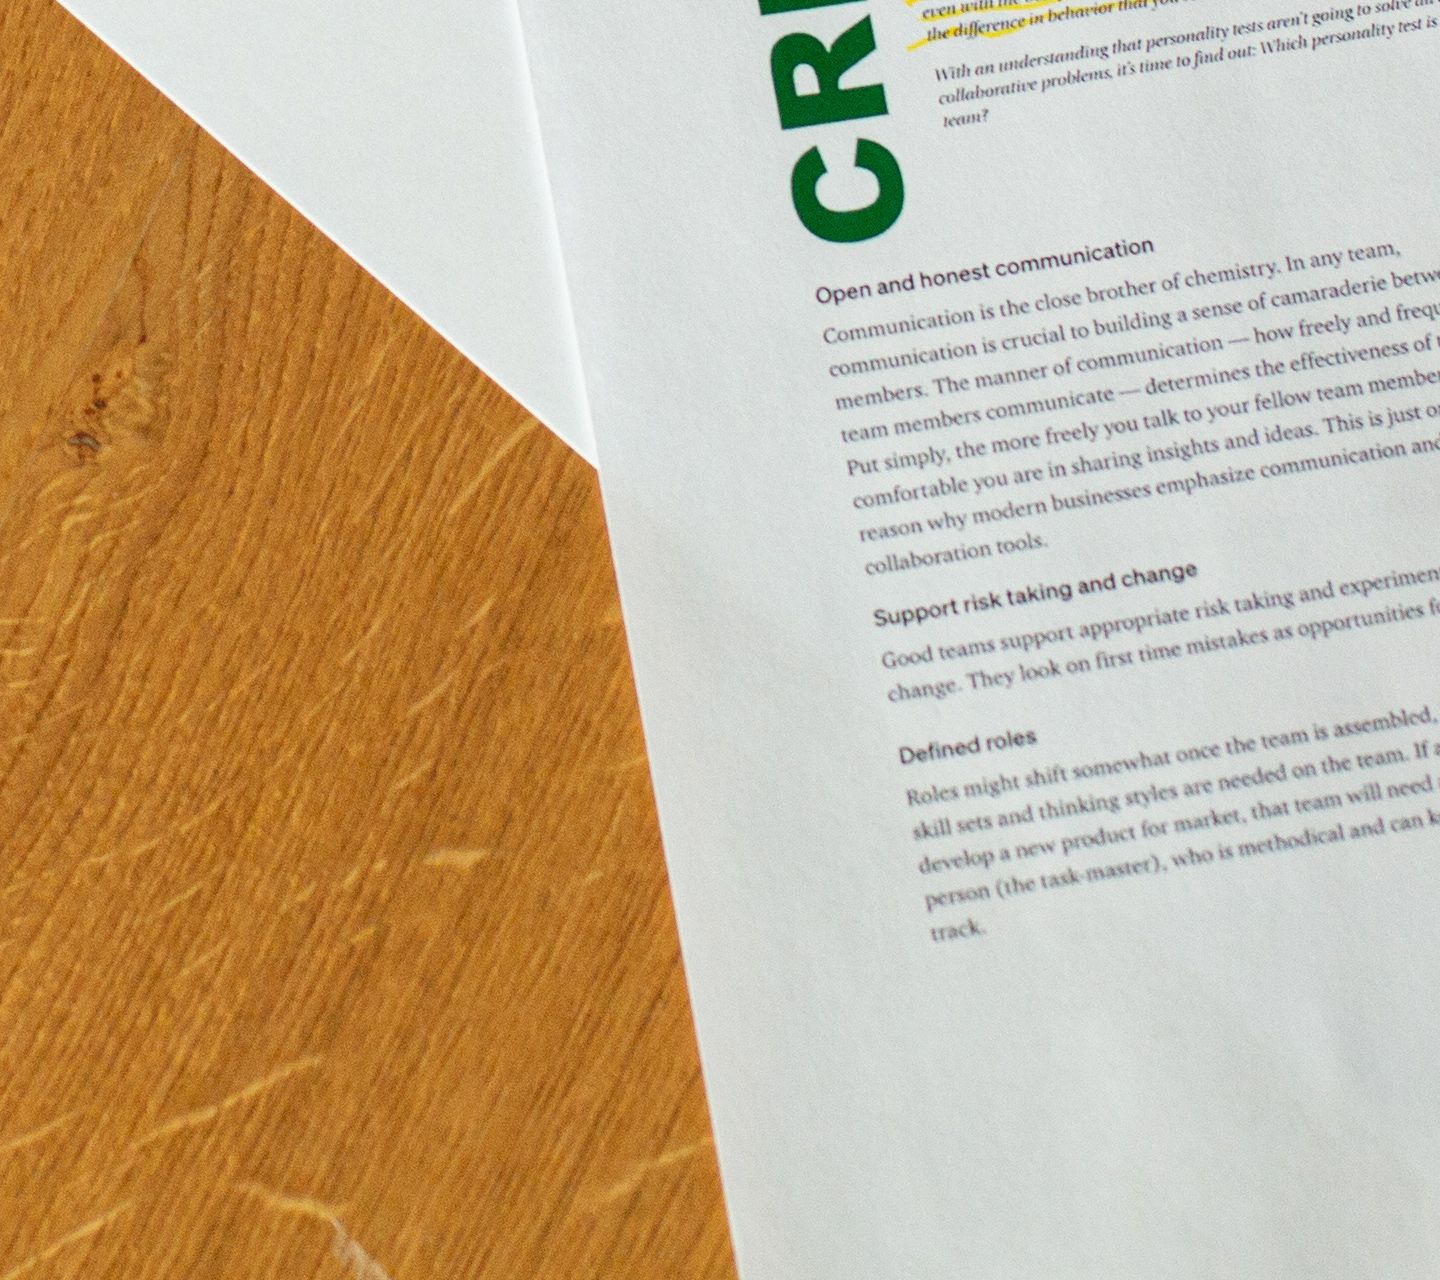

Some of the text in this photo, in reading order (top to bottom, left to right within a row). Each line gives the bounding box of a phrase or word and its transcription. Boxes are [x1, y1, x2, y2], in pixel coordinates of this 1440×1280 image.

[814, 238, 1155, 306] Open and honest communication
[821, 242, 1401, 345] Communication is the close brother of chemistry. In any team,
[872, 562, 1198, 628] Support risk taking and change
[897, 729, 1038, 766] Defined roles
